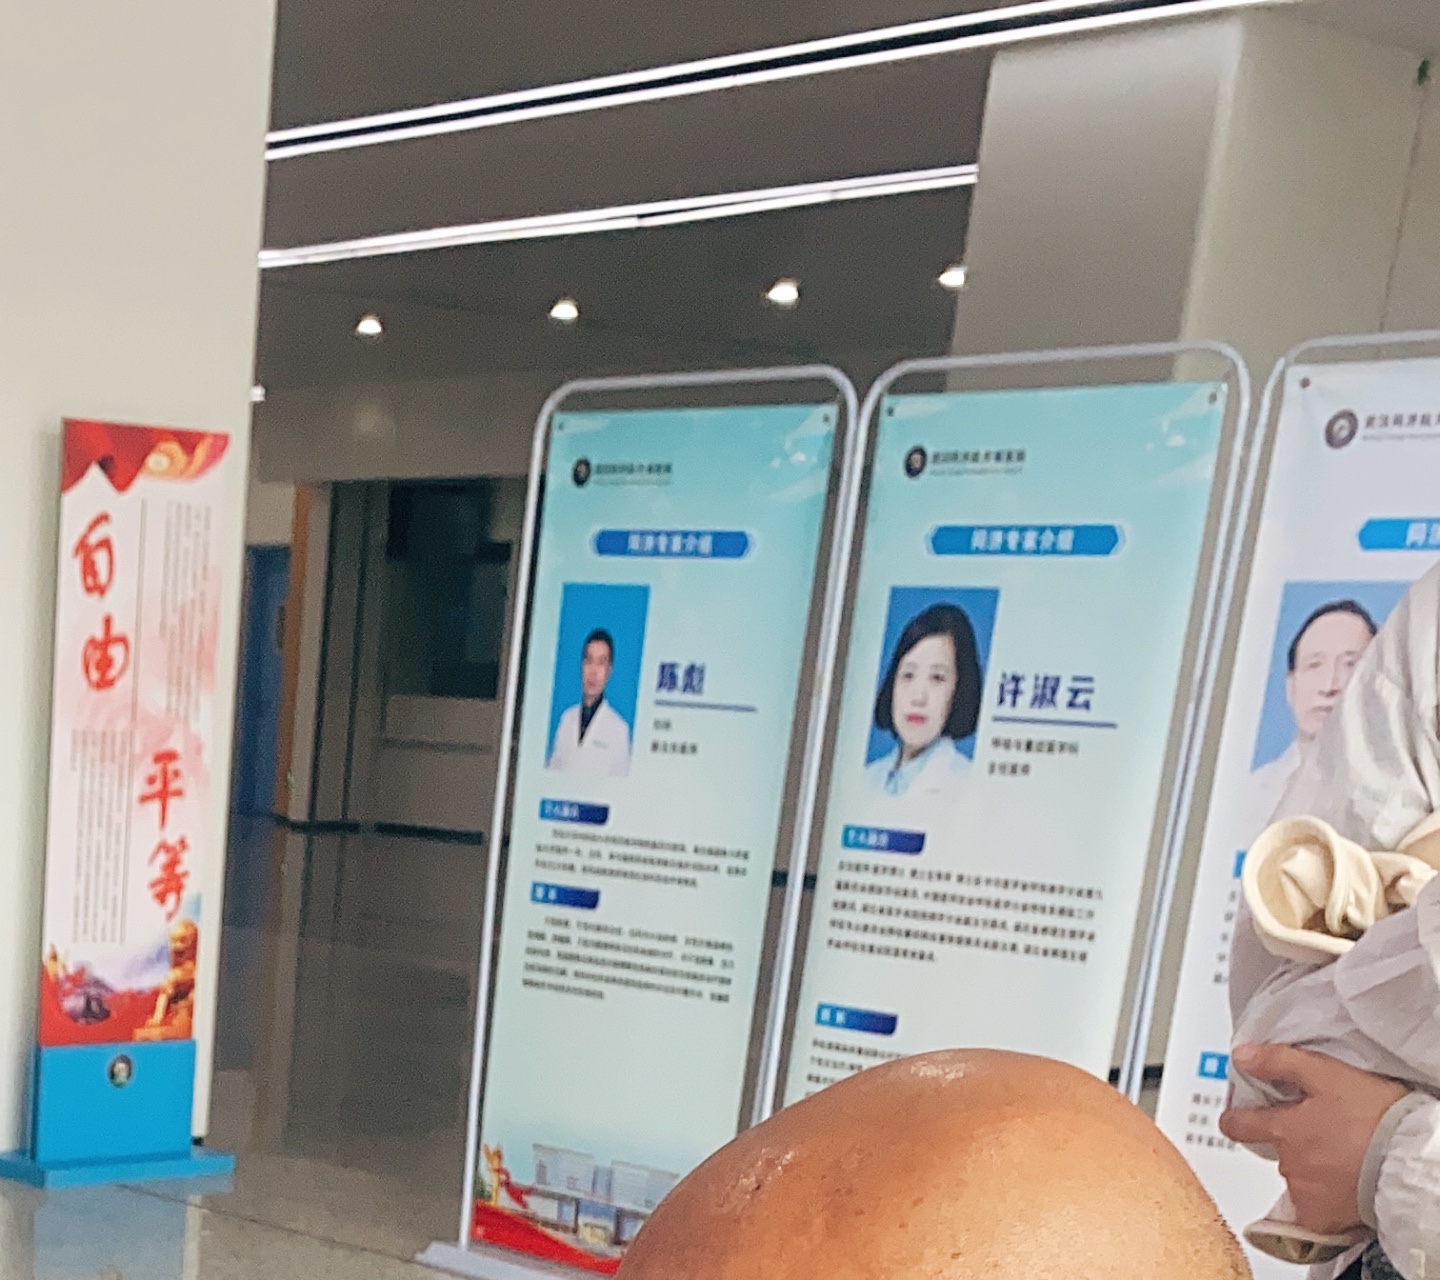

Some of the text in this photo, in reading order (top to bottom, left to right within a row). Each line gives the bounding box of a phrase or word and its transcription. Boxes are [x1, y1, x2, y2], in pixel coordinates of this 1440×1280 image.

[1365, 412, 1440, 429] 武汉同济航
[72, 511, 130, 690] 自由
[997, 671, 1095, 711] 许淑云
[138, 749, 190, 923] 平等
